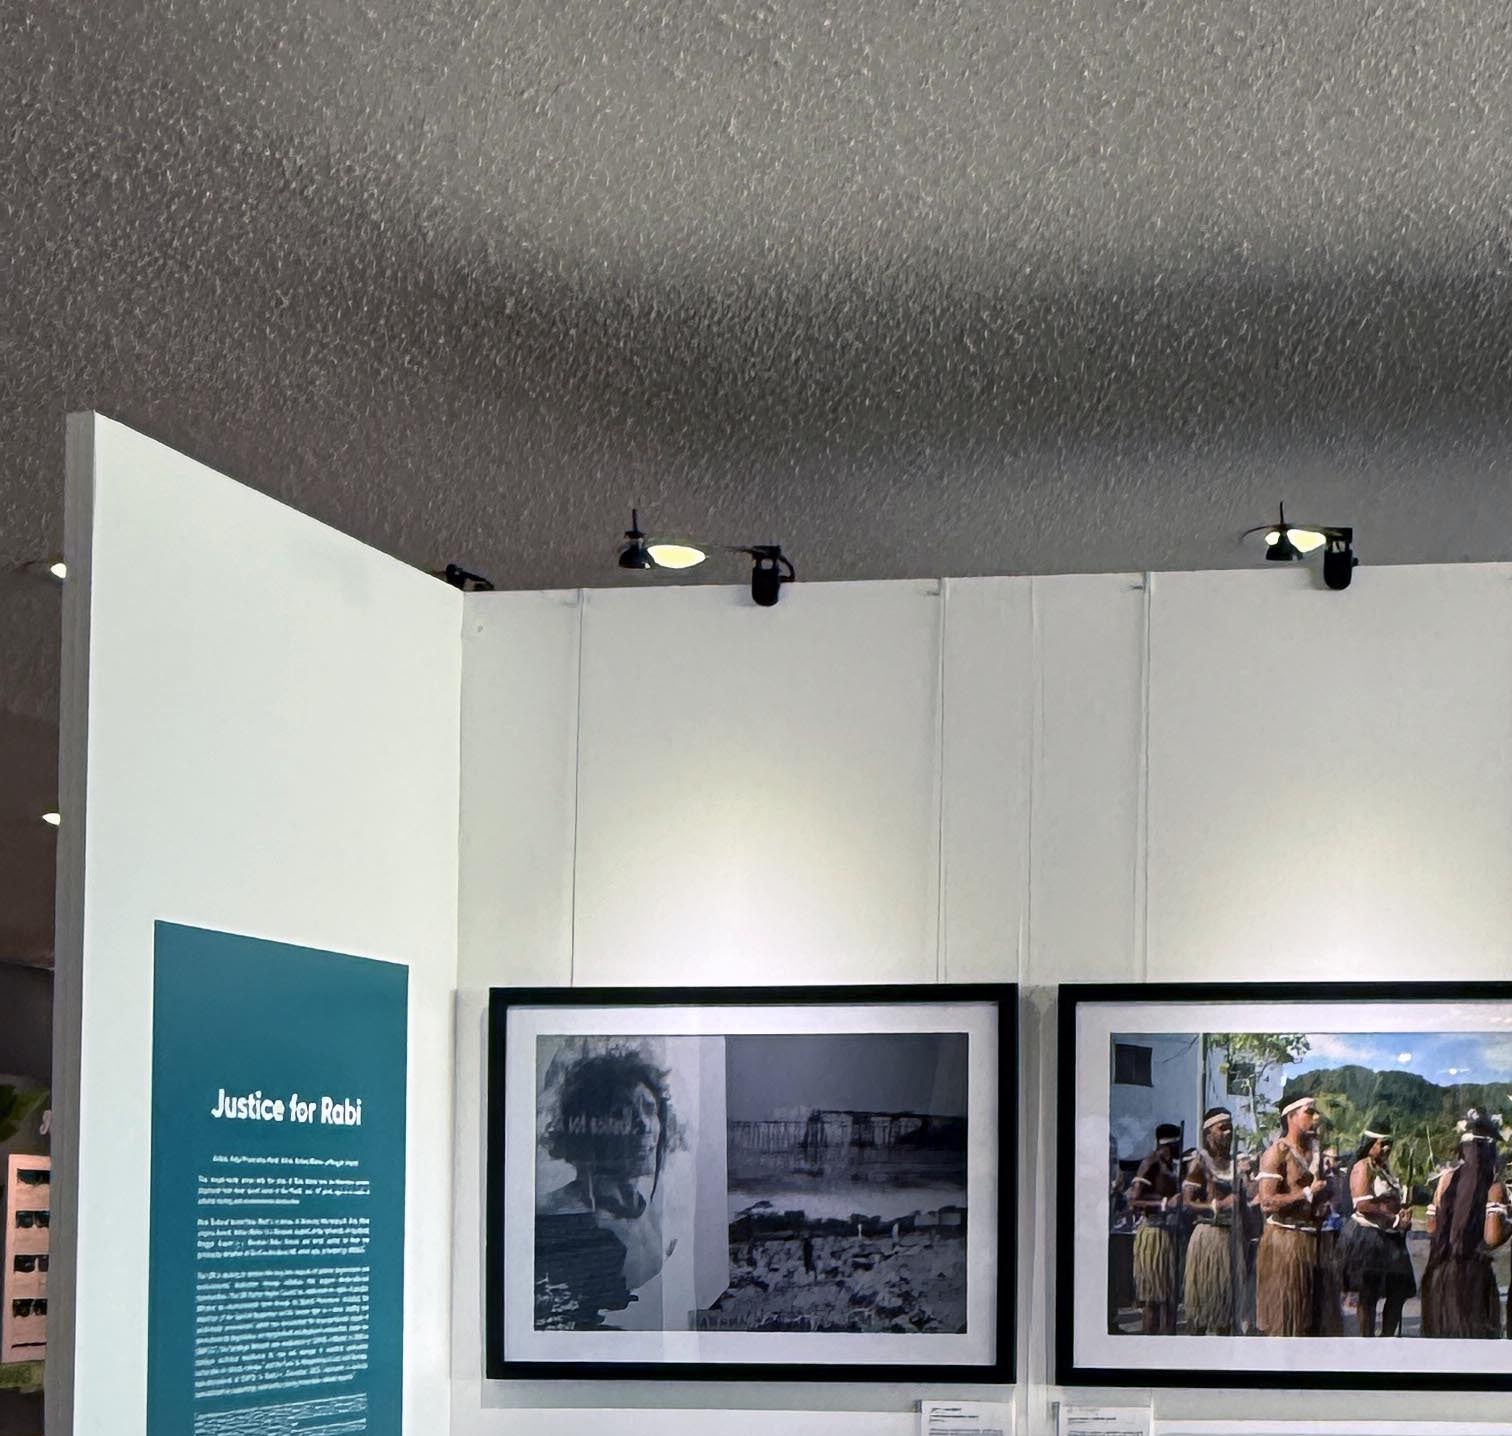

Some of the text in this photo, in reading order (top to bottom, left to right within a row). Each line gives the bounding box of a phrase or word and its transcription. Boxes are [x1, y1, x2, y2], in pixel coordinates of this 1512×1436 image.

[211, 1088, 362, 1126] Justice for Rabi
